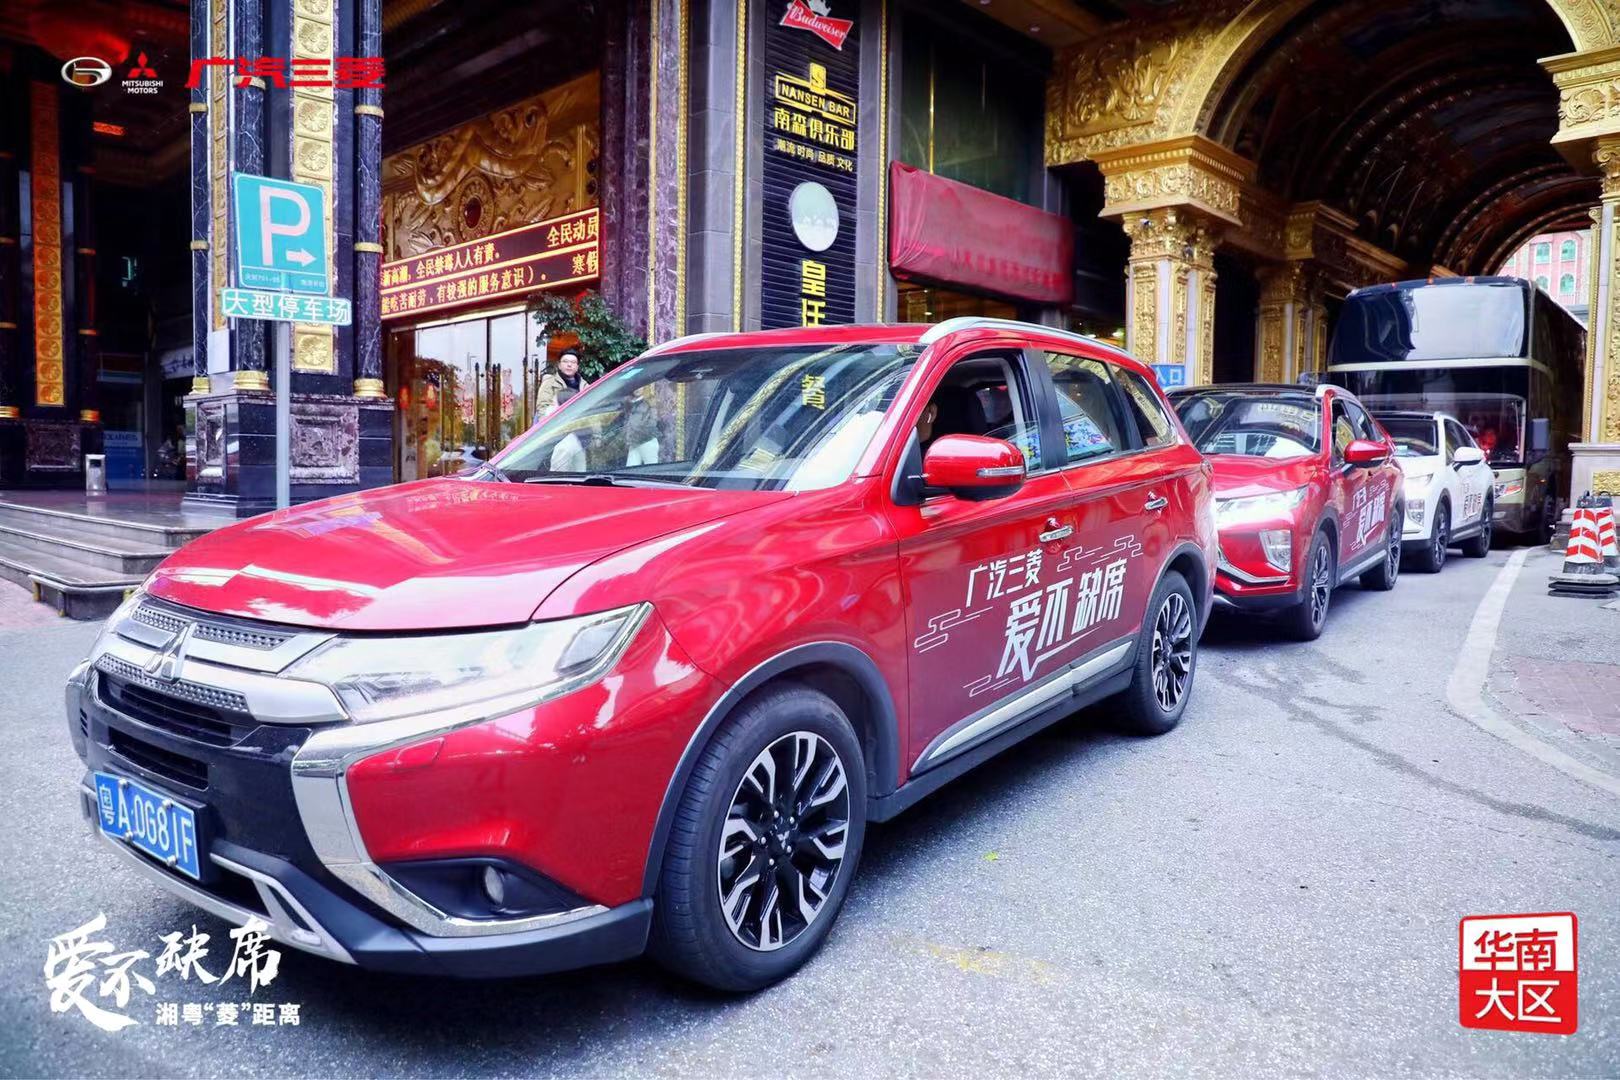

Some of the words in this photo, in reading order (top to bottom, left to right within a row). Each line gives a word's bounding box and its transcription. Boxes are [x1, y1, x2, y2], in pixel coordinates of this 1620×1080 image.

[789, 6, 847, 39] Budweiser
[781, 83, 826, 109] NANSEN
[829, 101, 850, 119] BAR
[774, 107, 855, 150] 南森俱乐部
[837, 156, 853, 172] 文化
[259, 185, 311, 266] P
[225, 289, 349, 325] 大型停车场
[966, 549, 1043, 608] 广汽三菱
[996, 558, 1128, 682] 爱不缺席
